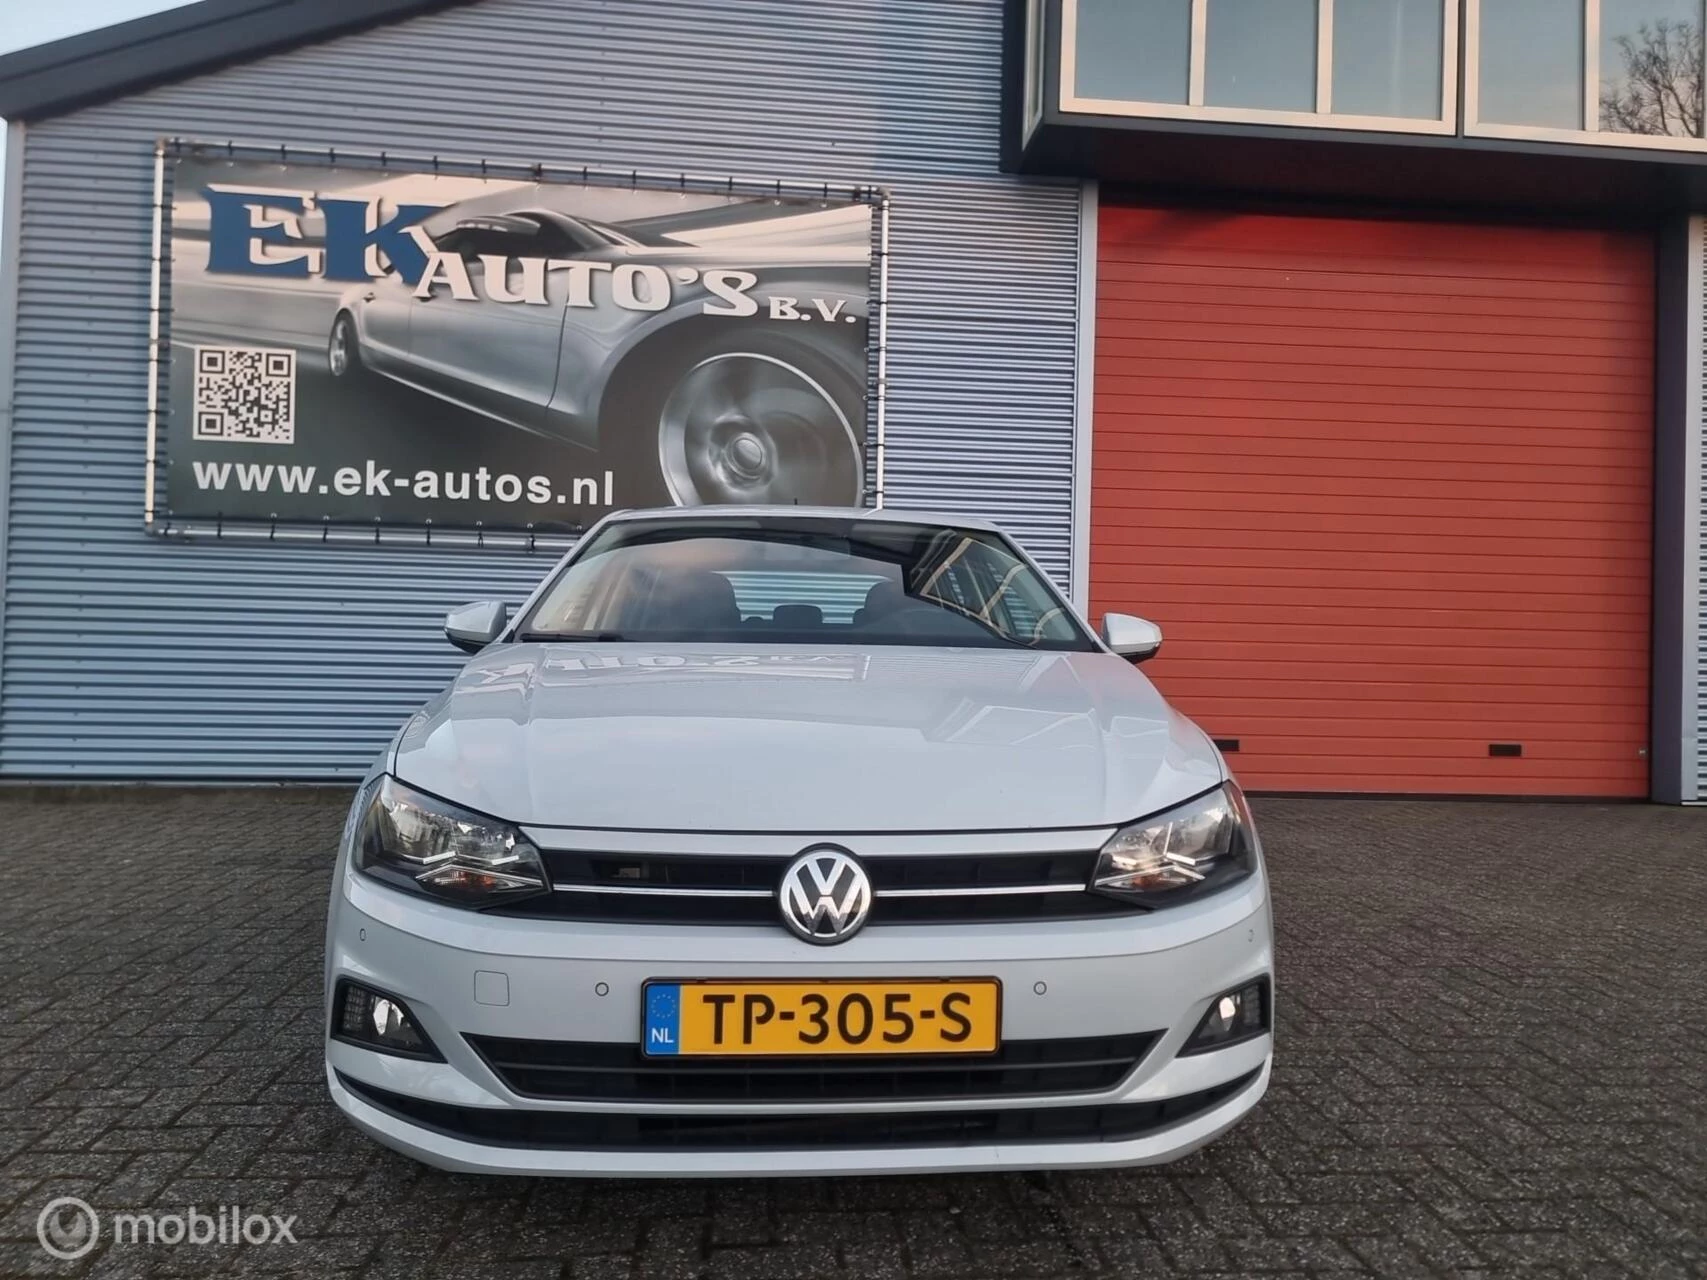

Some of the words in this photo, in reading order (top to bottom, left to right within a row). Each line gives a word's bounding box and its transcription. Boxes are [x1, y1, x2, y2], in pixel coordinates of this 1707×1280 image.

[203, 182, 456, 286] EK
[768, 295, 857, 323] B.V.
[193, 459, 613, 506] www.ek-autos.nl
[651, 1027, 674, 1044] NL
[703, 992, 973, 1045] TP-305-S
